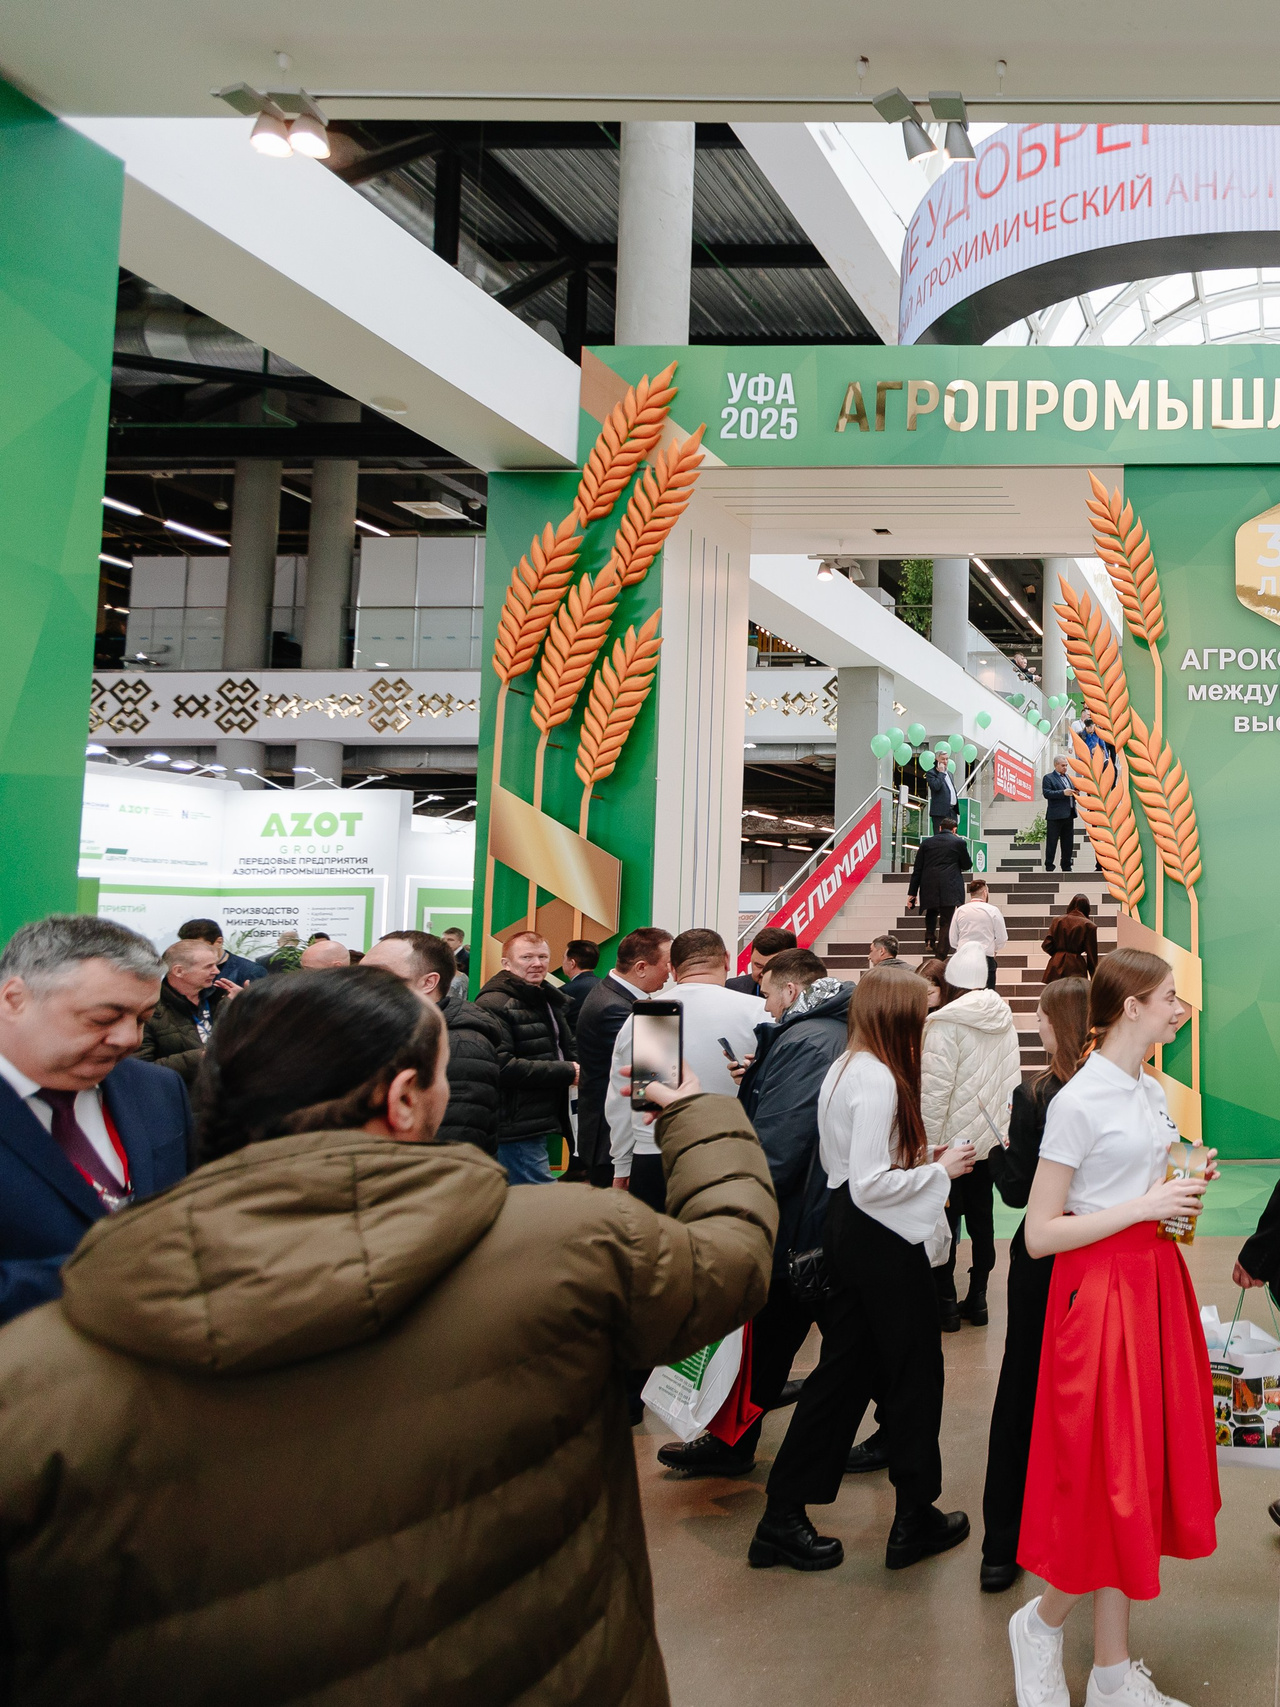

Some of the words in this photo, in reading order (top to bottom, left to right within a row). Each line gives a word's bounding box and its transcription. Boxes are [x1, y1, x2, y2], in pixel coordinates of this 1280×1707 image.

[915, 173, 1152, 315] АГРОХИМИЧЕСКИЙ
[727, 372, 795, 405] УФА
[720, 407, 798, 440] 2025
[260, 812, 363, 837] AZOT
[280, 845, 344, 854] GROUP
[299, 857, 368, 865] ПРЕДПРИЯТИЯ
[233, 867, 276, 875] АЗОТНОЙ
[781, 824, 878, 936] ЕЛЬМАШ
[223, 907, 299, 915] ПРОИЗВОДСТВО
[240, 929, 298, 938] УДОБРЕ
